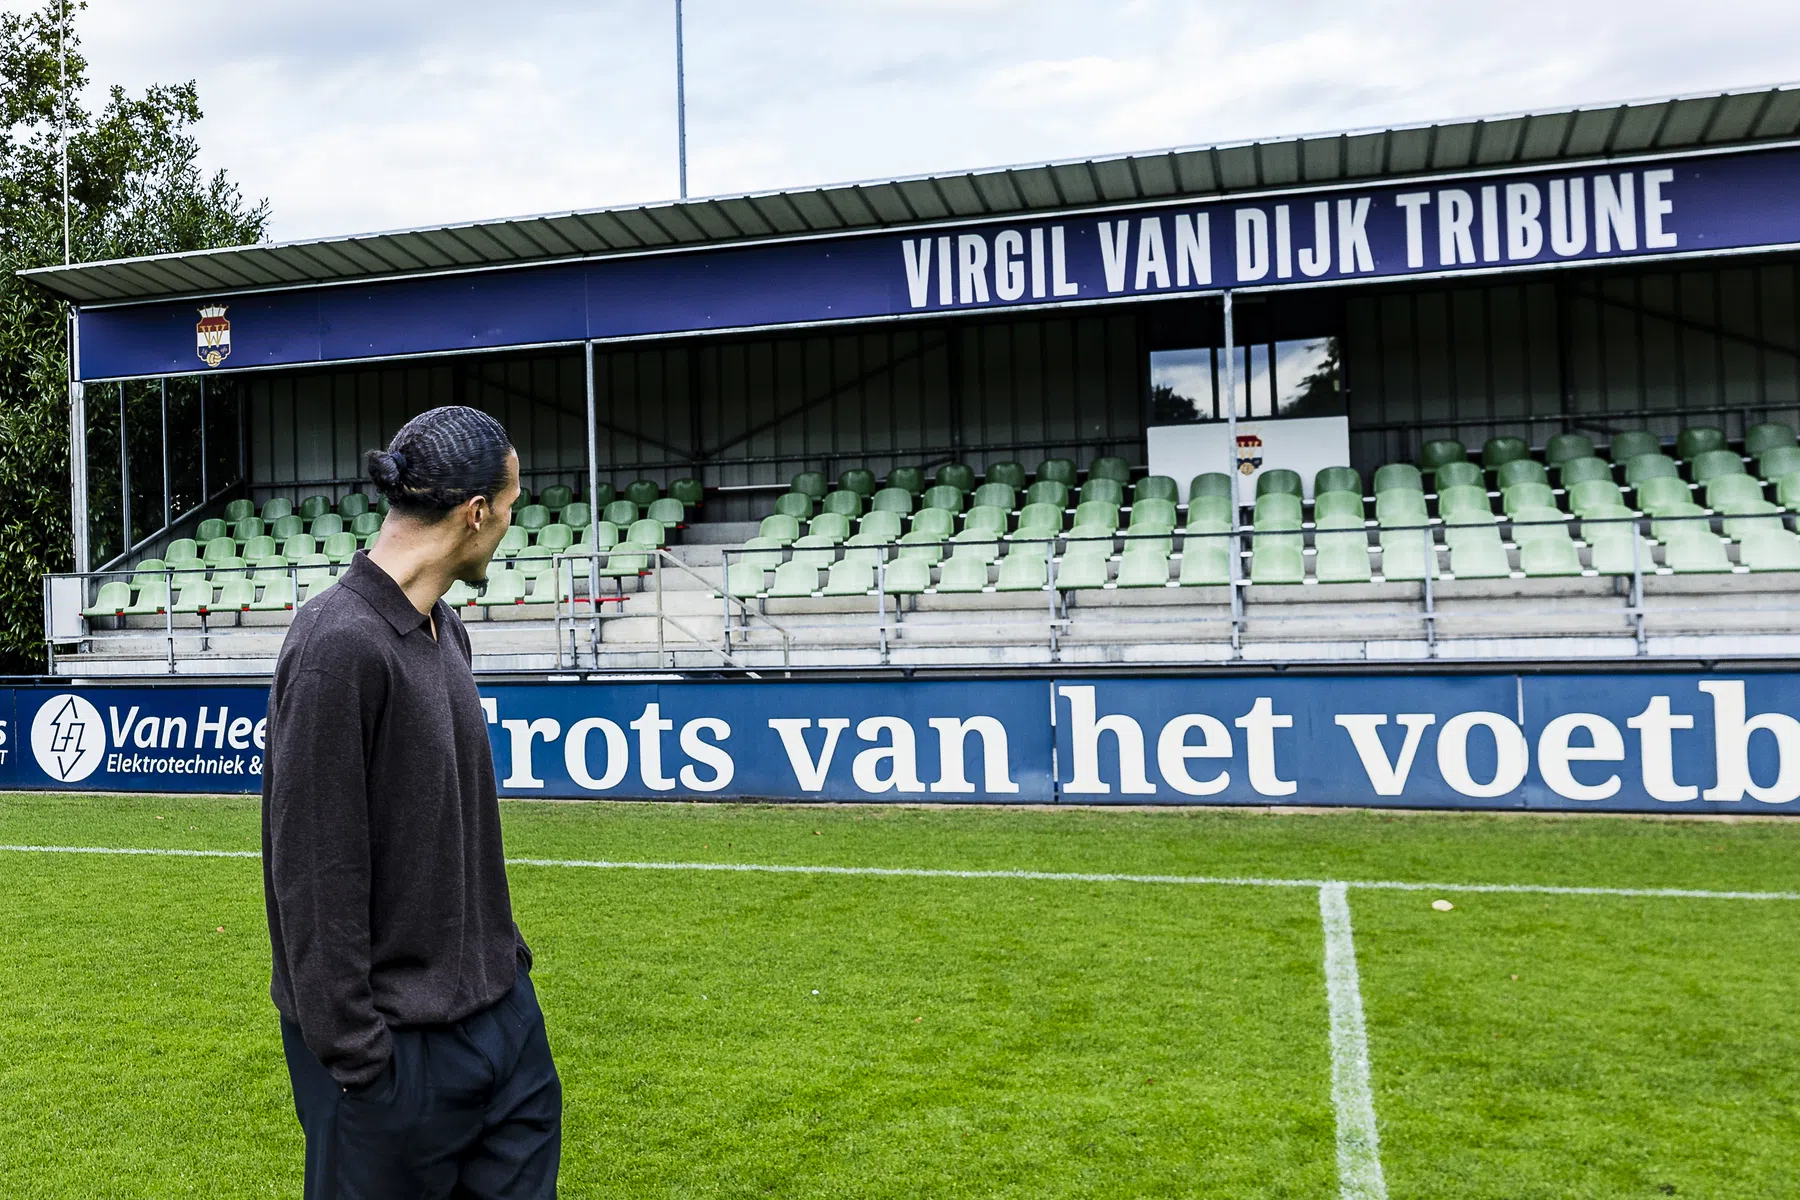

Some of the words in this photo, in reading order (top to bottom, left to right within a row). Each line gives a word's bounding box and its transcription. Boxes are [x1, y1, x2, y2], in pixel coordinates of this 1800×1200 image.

[902, 225, 1079, 308] VIRGIL
[1097, 211, 1212, 294] VAN
[1235, 197, 1375, 282] DIJK
[1396, 169, 1678, 269] TRIBUNE
[106, 752, 245, 775] Elektrotechniek
[248, 755, 264, 775] &
[109, 705, 187, 749] Van
[484, 697, 735, 793] rots
[768, 716, 1020, 794] van
[1055, 685, 1298, 796] het
[1335, 679, 1800, 804] voetb
